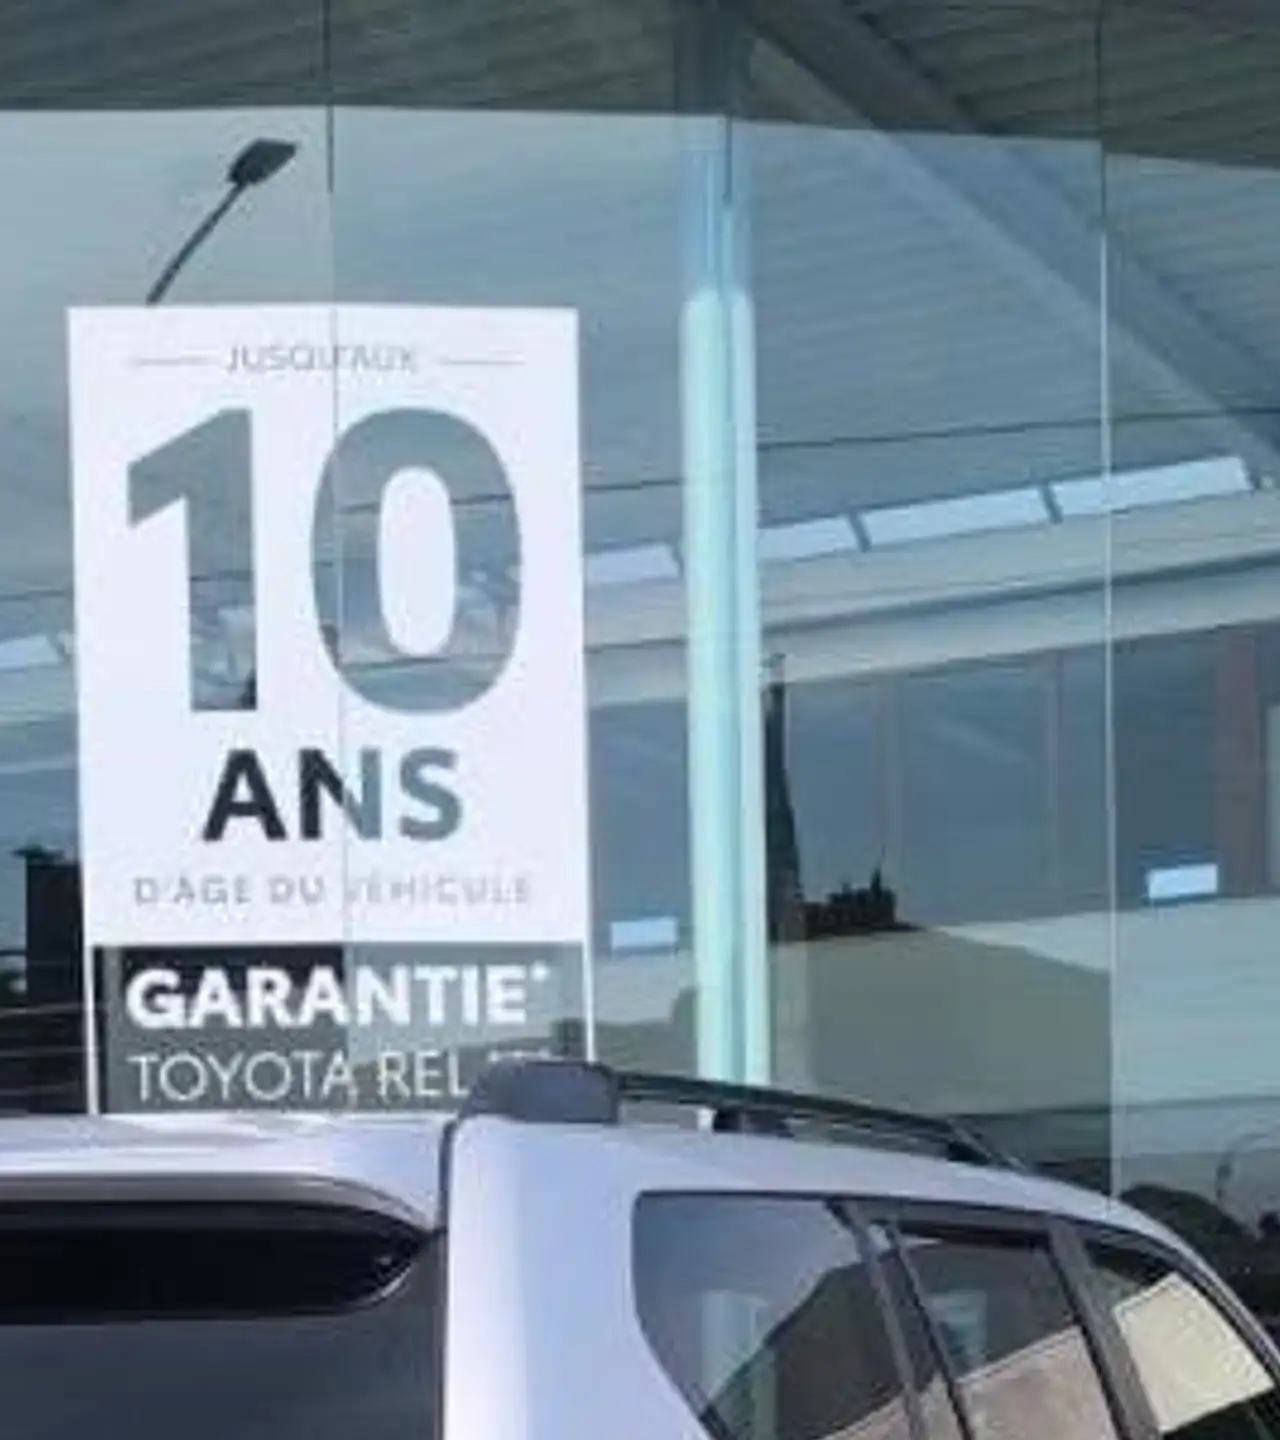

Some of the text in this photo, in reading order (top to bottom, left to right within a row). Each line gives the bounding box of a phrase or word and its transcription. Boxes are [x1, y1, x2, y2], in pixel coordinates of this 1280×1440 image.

[127, 408, 522, 714] 10
[202, 747, 463, 842] ANS
[267, 873, 326, 906] DU
[126, 1050, 356, 1101] TOYOTA
